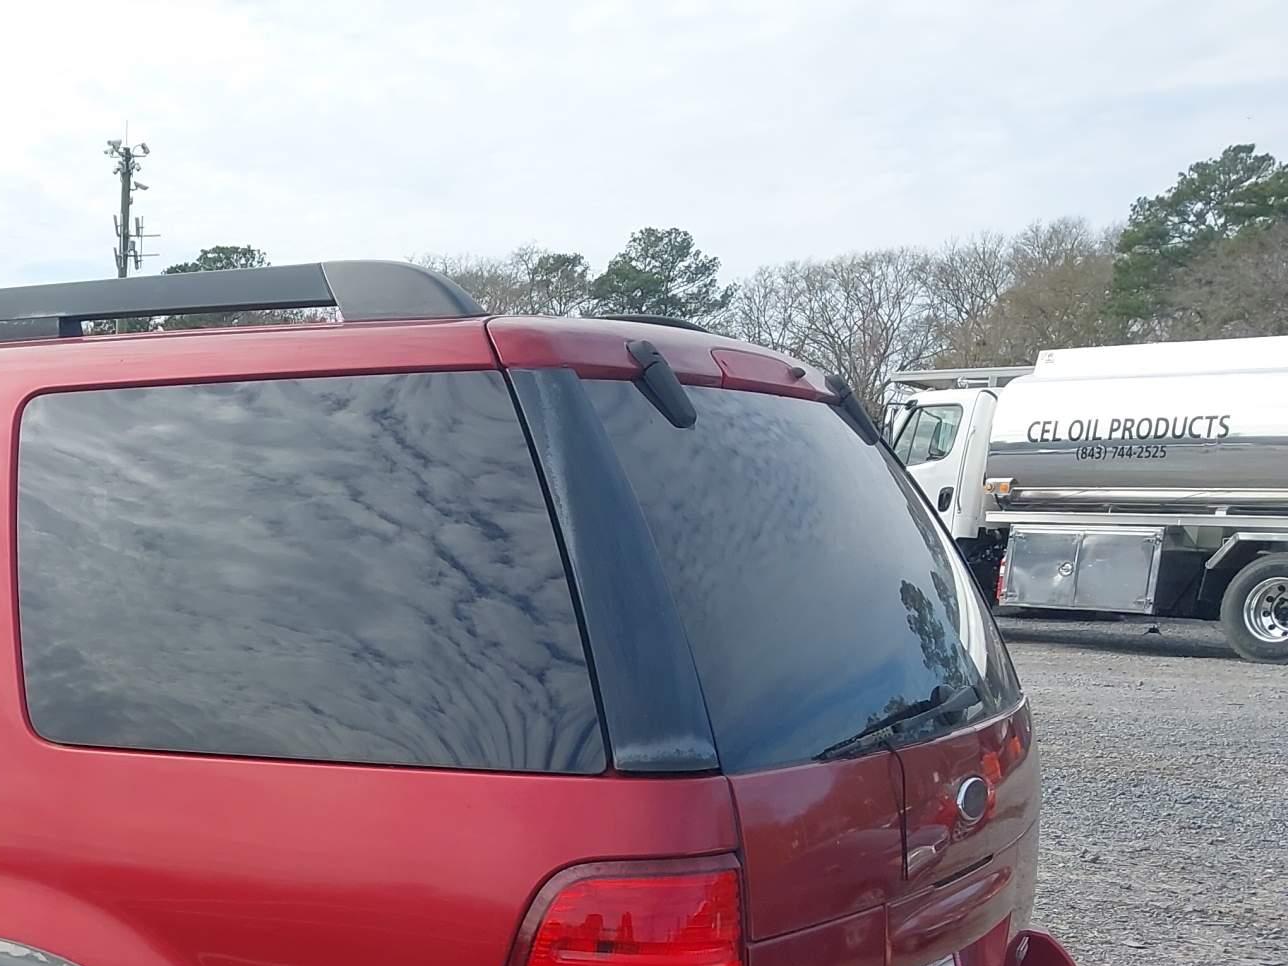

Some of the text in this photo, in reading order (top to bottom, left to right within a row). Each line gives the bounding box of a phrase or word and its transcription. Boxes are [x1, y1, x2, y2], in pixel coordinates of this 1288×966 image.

[1027, 414, 1231, 444] CEL OIL PRODUCTS
[1075, 444, 1167, 462] (843) 744-2525
